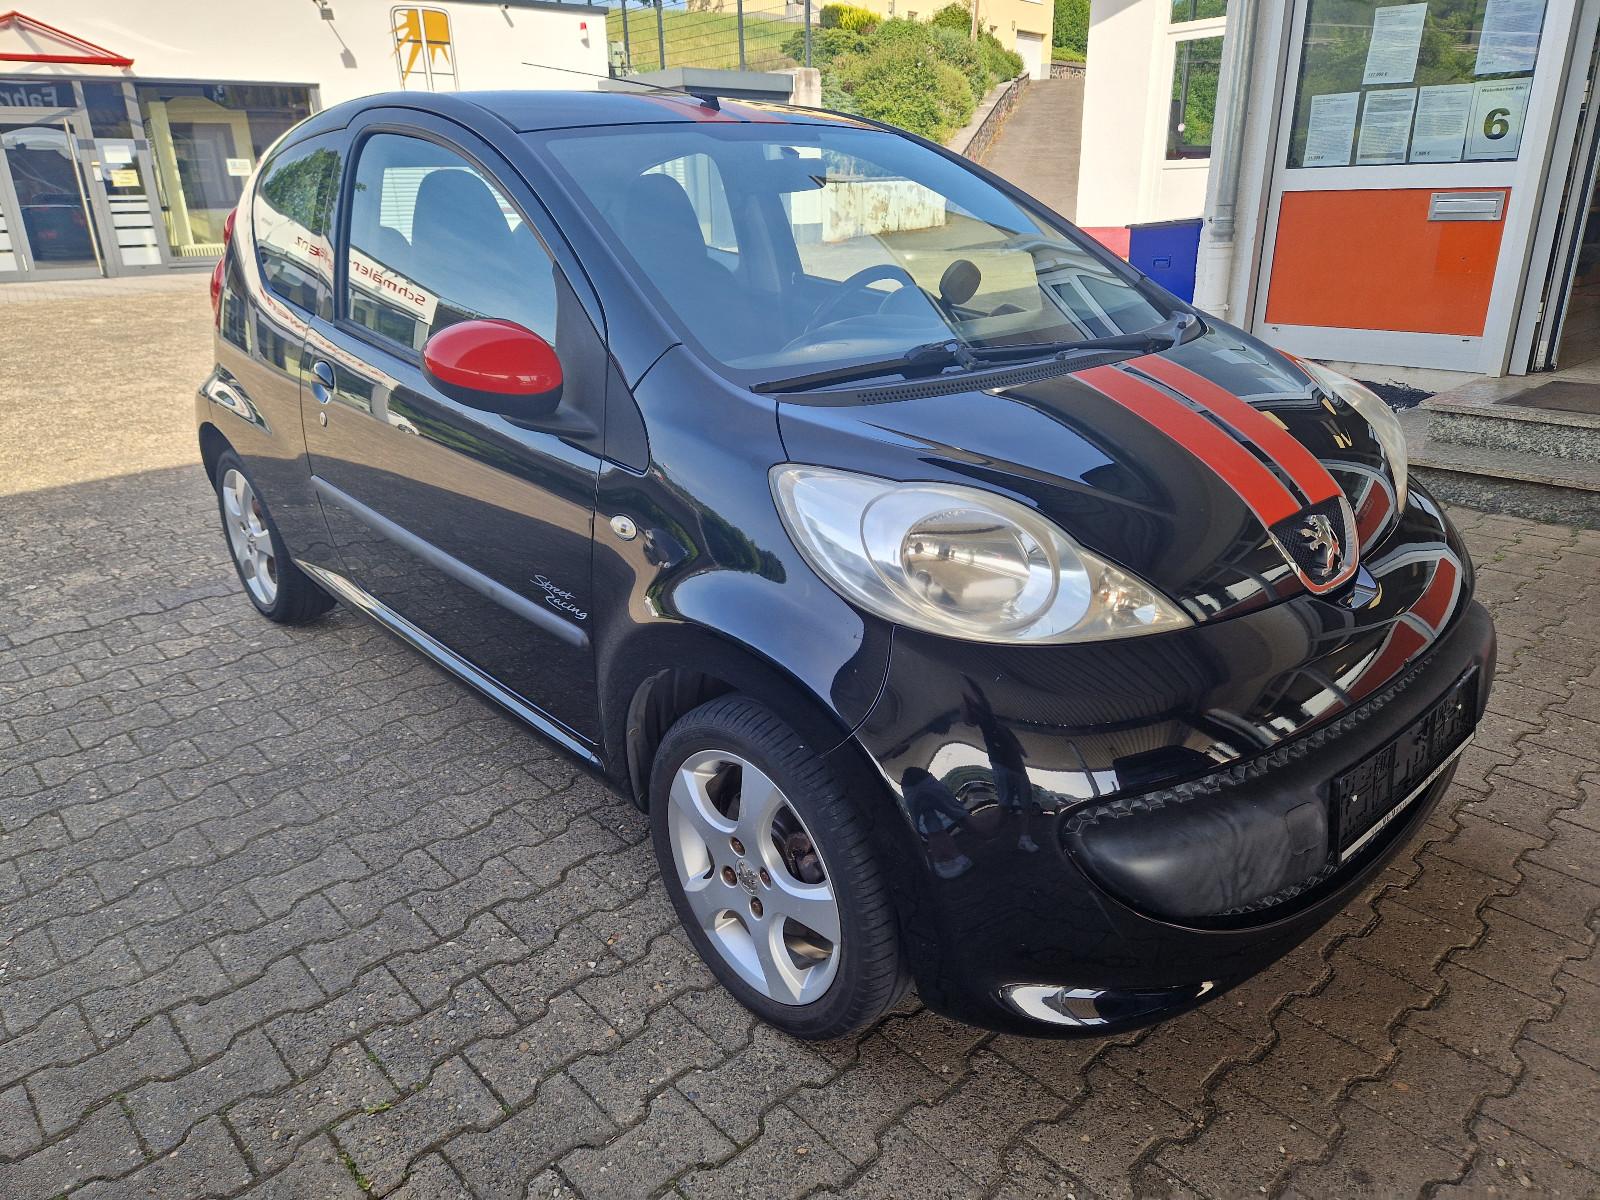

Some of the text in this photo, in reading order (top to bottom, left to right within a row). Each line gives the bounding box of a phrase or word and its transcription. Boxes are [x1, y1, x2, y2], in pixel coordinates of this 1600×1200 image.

[1484, 108, 1510, 140] 6
[530, 574, 576, 600] Street
[542, 586, 588, 620] Racing
